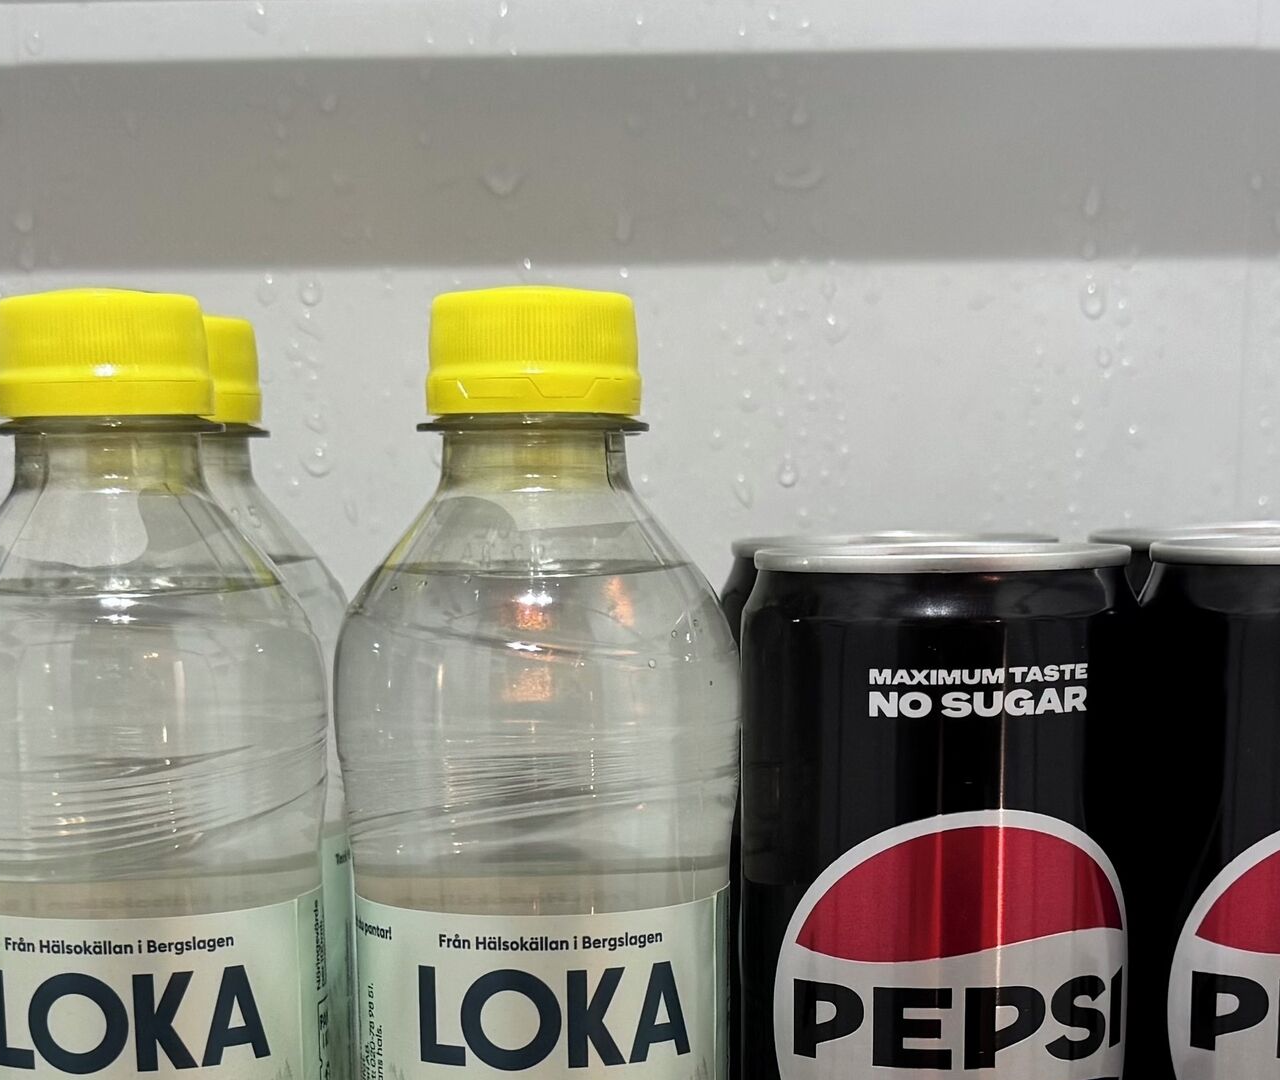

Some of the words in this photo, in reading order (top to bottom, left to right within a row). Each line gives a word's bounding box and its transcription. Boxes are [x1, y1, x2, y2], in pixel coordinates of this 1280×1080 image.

[868, 667, 1005, 686] MAXIMUM
[1009, 662, 1089, 684] TASTE
[868, 690, 932, 718] NO
[941, 686, 1088, 718] SUGAR
[4, 937, 36, 953] Från
[39, 940, 133, 956] Hälsokällan
[137, 939, 143, 955] i
[146, 935, 235, 956] Bergslagen
[438, 933, 471, 950] Från
[475, 936, 569, 952] Hälsokällan
[573, 936, 578, 950] i
[581, 930, 663, 951] Bergslagen
[418, 960, 691, 1072] LOKA
[793, 966, 1123, 1070] PEPSI
